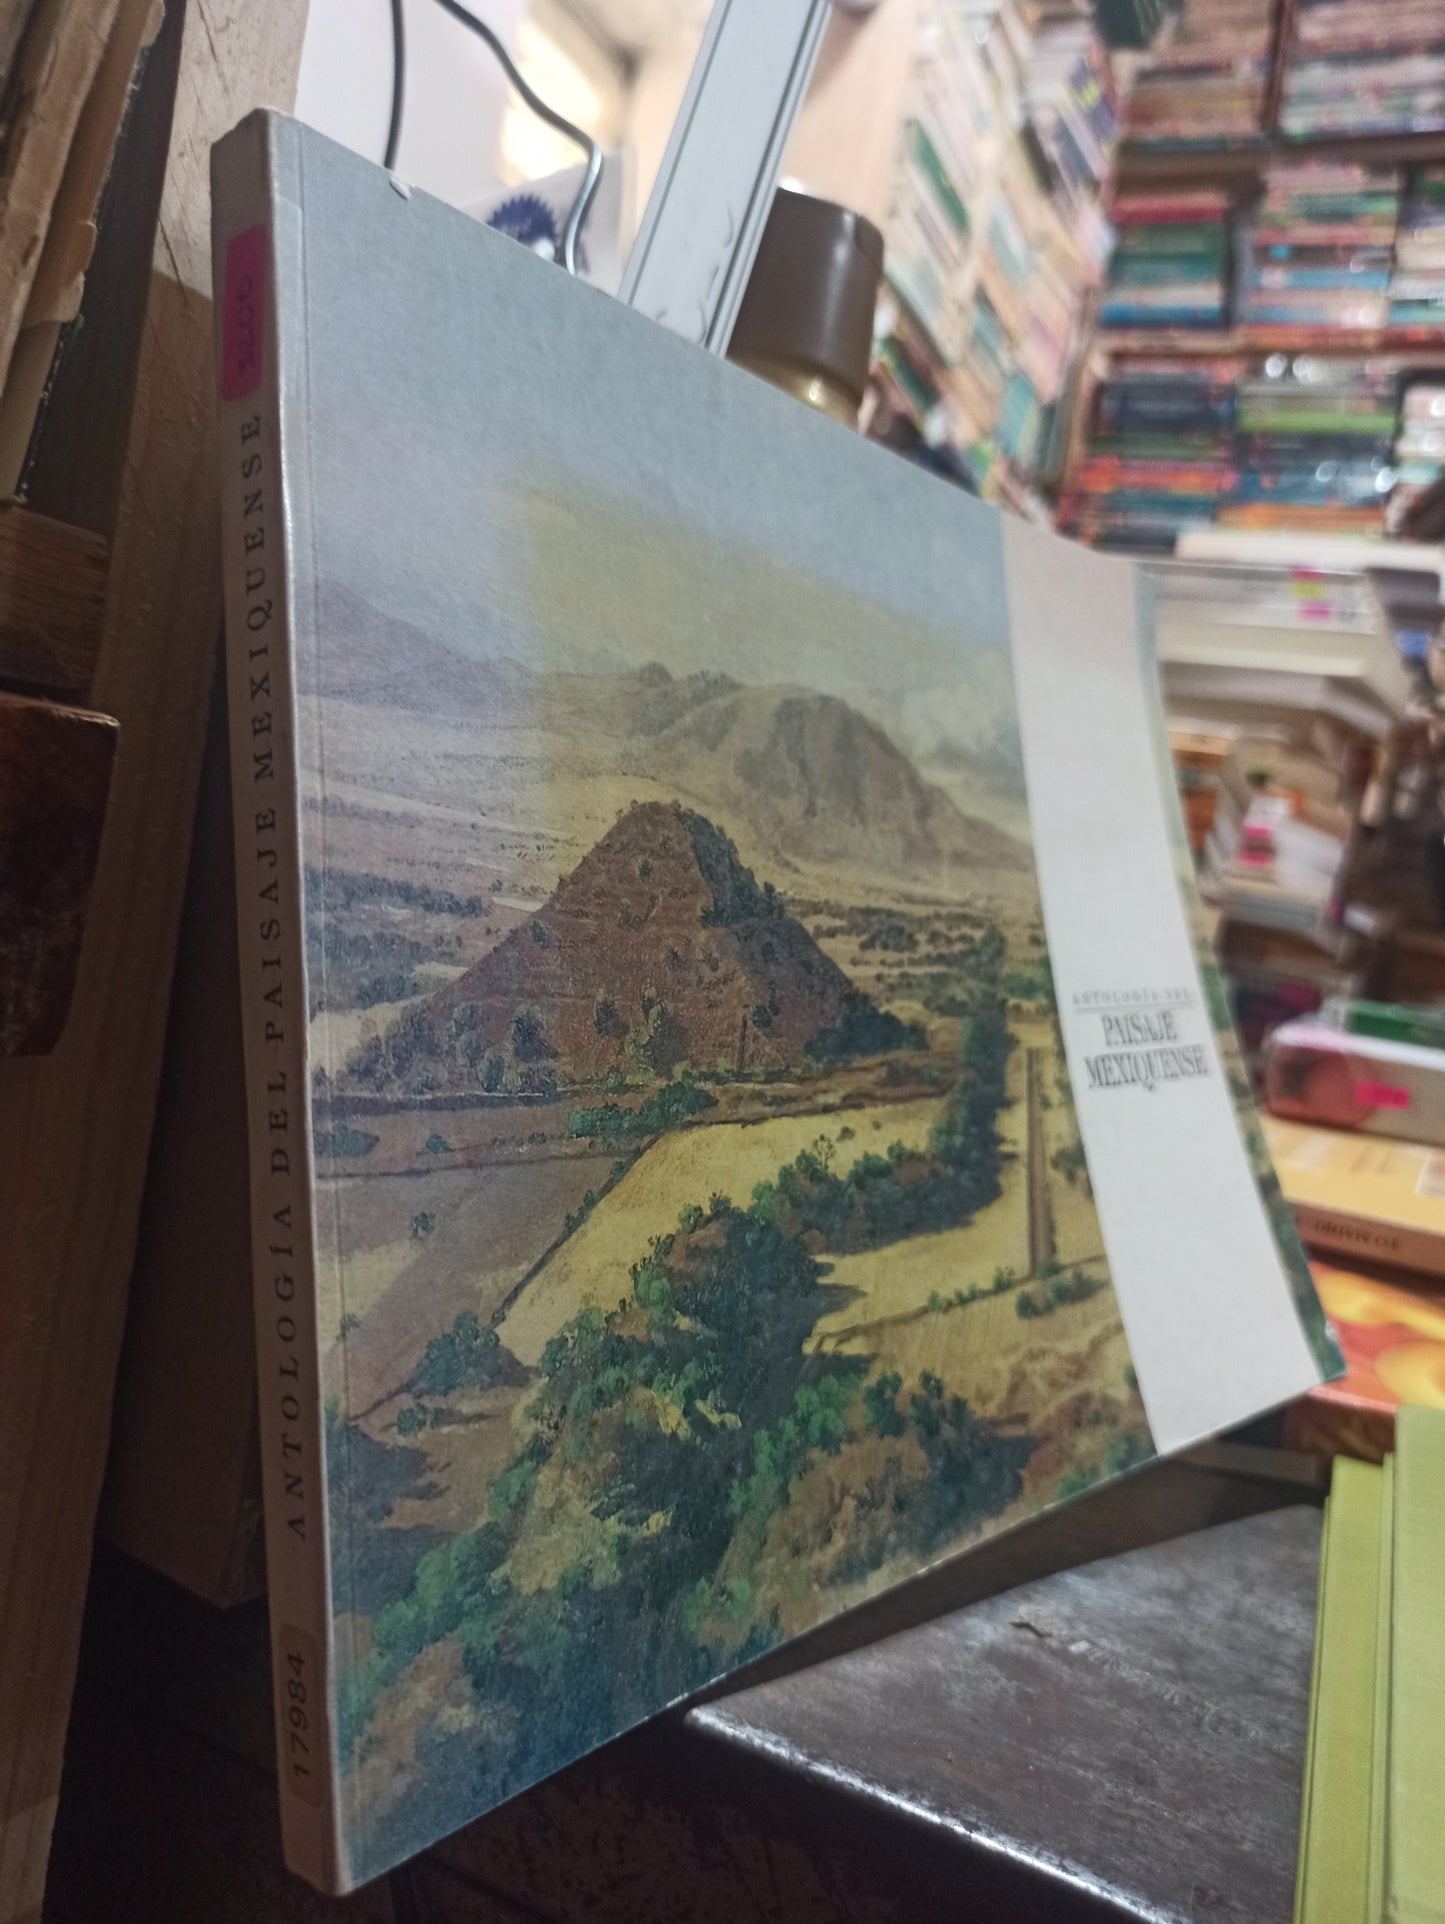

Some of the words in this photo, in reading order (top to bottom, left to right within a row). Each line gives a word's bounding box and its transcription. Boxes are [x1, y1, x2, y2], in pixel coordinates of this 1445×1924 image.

[241, 415, 273, 783] MEXIQUENSE
[256, 807, 284, 1043] PAISAJE
[1084, 1044, 1209, 1091] MEXIQUENSE
[1101, 1010, 1178, 1046] PAISAJE
[267, 1070, 290, 1176] DEL
[269, 1204, 306, 1540] ANTOLOGÍA
[286, 1652, 311, 1777] 17984
